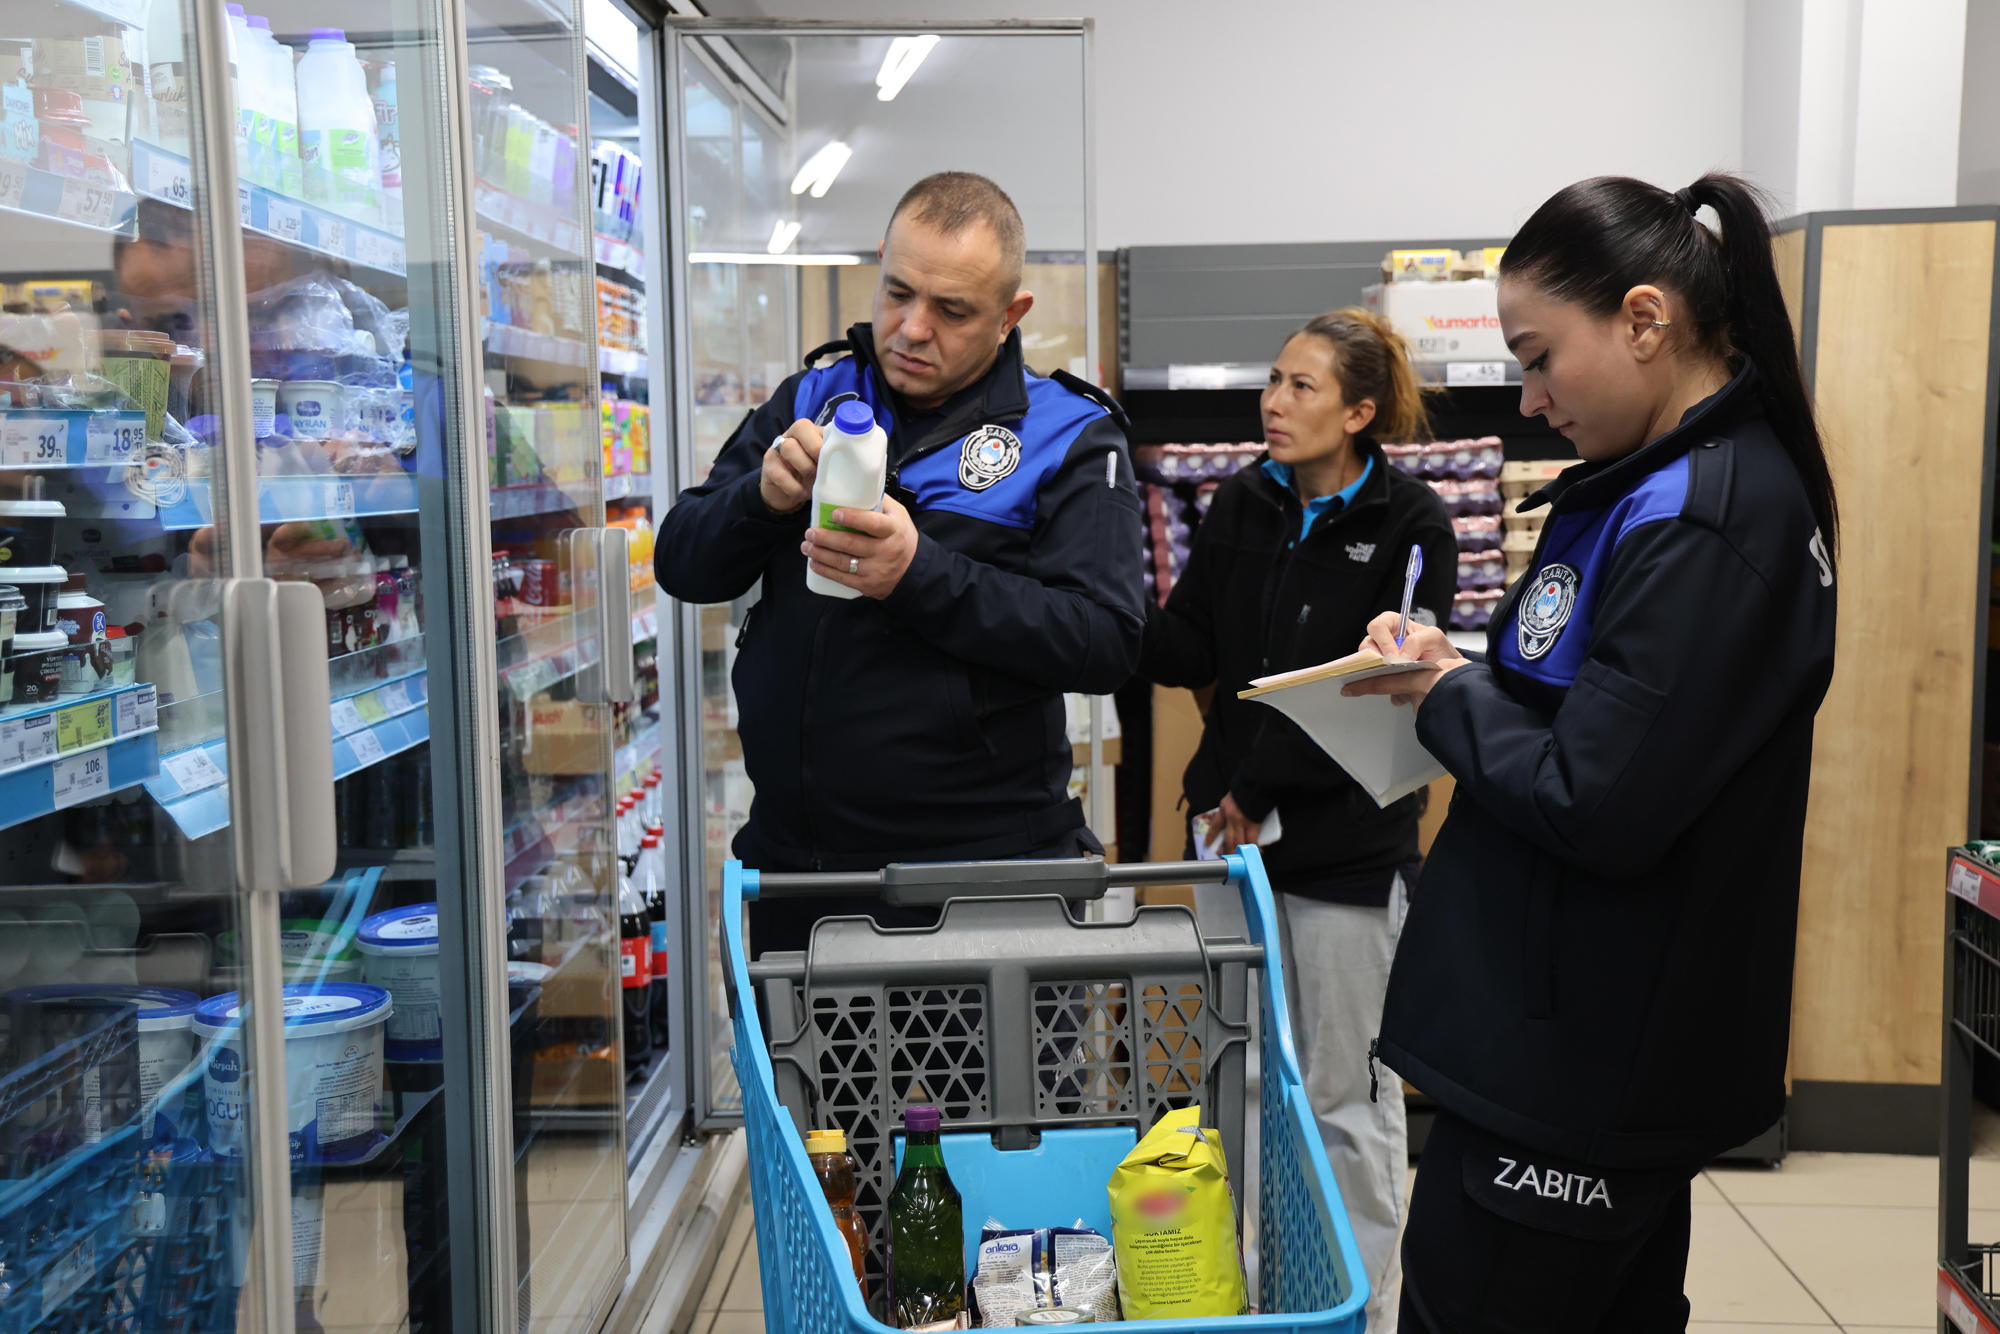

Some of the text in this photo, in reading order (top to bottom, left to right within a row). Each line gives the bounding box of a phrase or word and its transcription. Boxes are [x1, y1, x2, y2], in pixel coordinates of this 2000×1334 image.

[6, 96, 29, 112] DANONE
[14, 120, 34, 150] Mix
[173, 176, 185, 197] 65
[294, 419, 327, 428] AYRAN
[37, 435, 56, 458] 39
[55, 448, 62, 457] TL
[988, 428, 1017, 449] ZABITA
[1544, 567, 1572, 585] ZABITA
[86, 758, 100, 774] 106
[1494, 1157, 1613, 1208] ZABITA
[985, 1242, 1019, 1254] ankara
